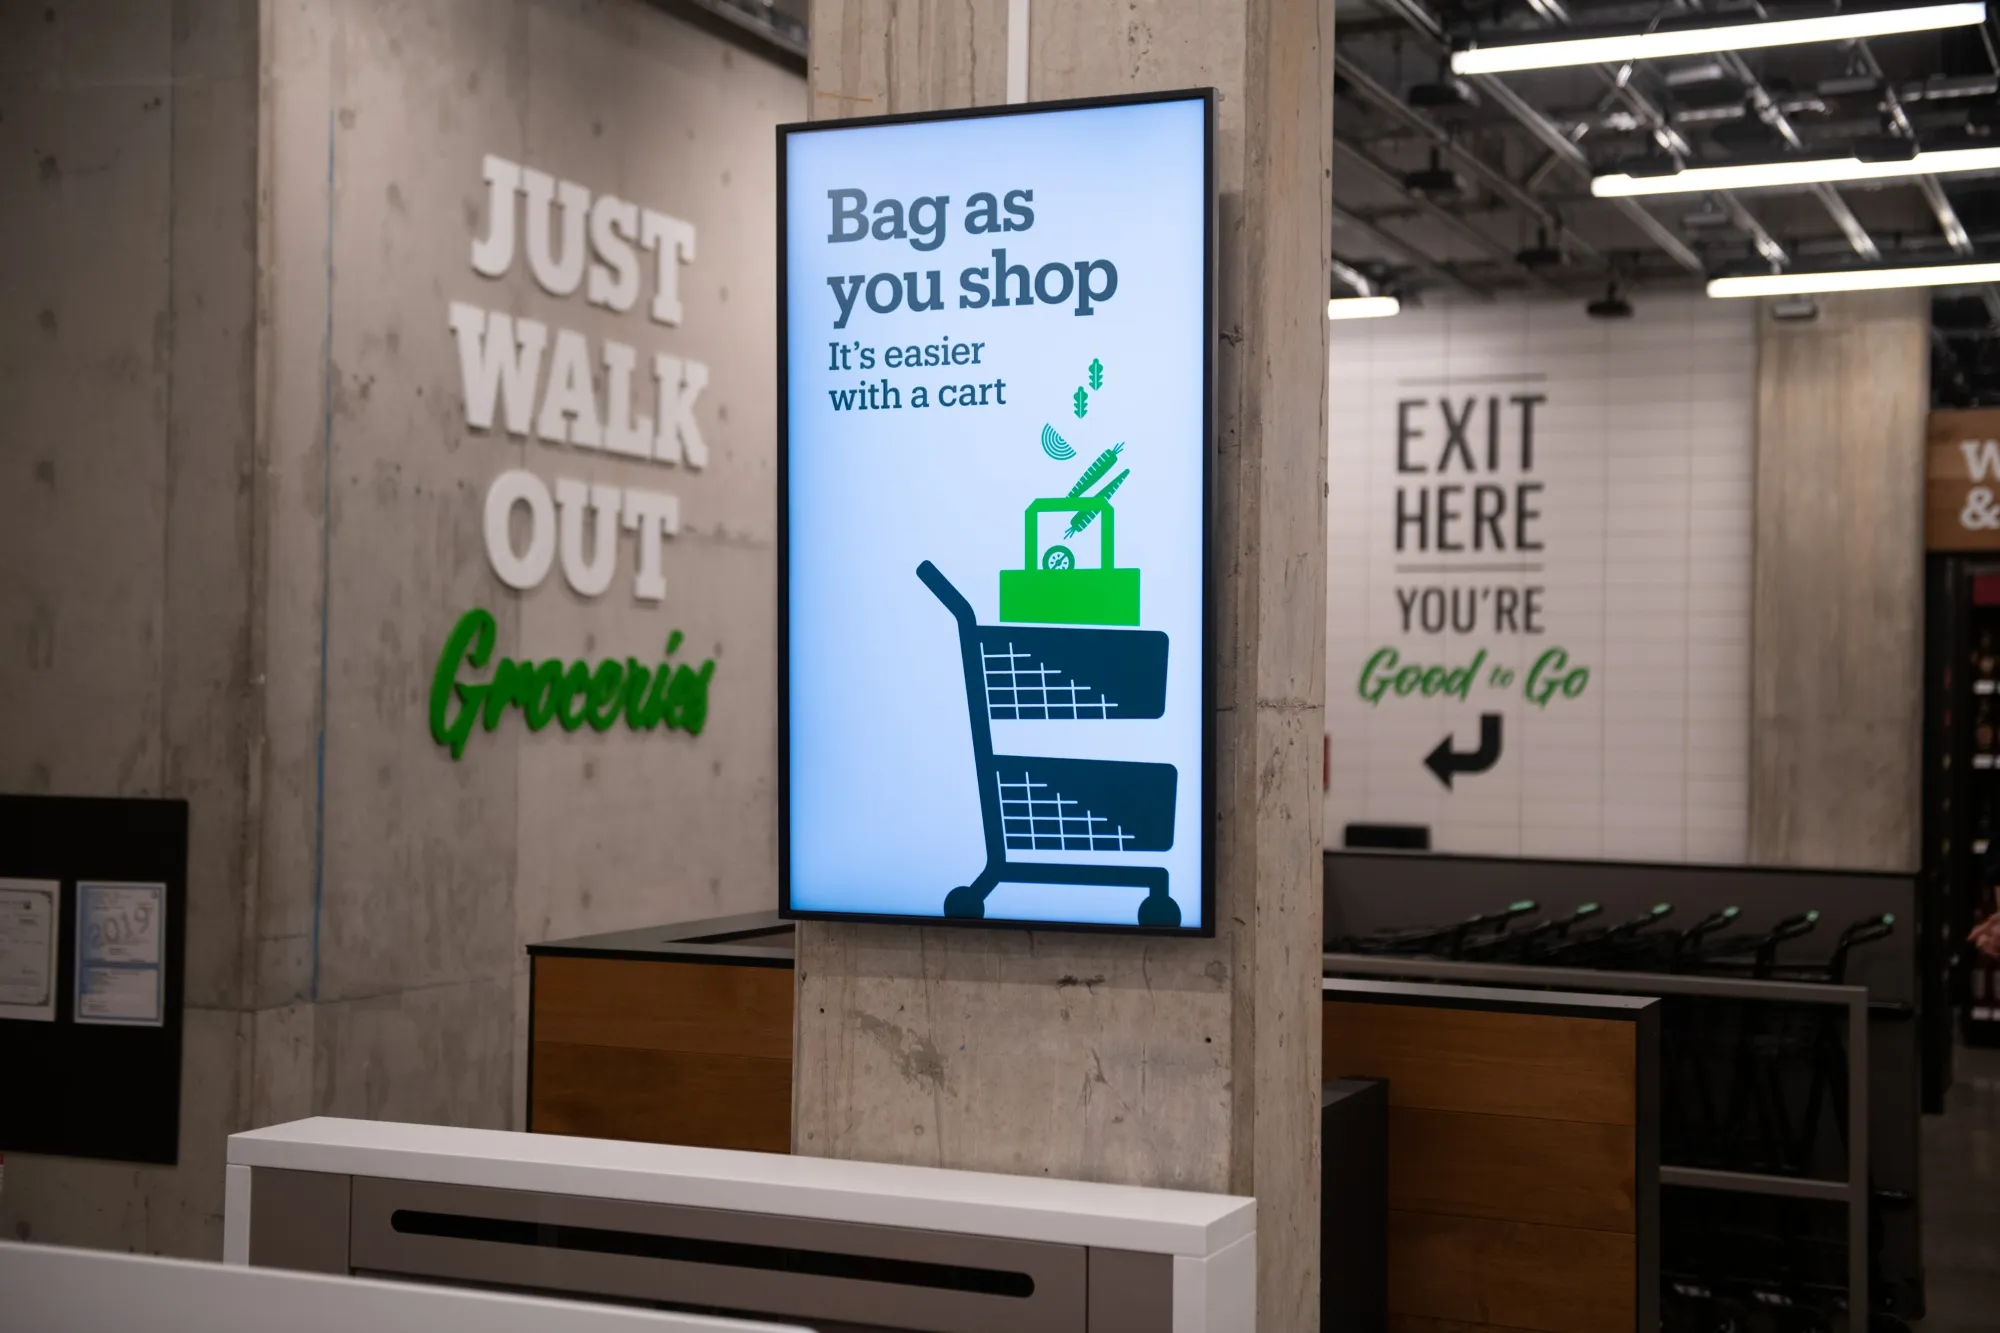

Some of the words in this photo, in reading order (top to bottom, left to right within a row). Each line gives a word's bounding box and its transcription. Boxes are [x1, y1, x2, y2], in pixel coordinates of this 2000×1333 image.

[471, 154, 695, 328] JUST
[827, 188, 950, 252] Bag
[964, 189, 1035, 234] as
[827, 270, 945, 329] you
[959, 248, 1118, 316] shop
[449, 301, 709, 468] WALK
[829, 341, 876, 371] It's
[884, 335, 985, 368] easier
[828, 379, 902, 411] with
[910, 387, 930, 408] a
[938, 378, 1007, 407] cart
[1396, 394, 1547, 474] EXIT
[484, 469, 679, 601] OUT
[1396, 483, 1545, 553] HERE
[1395, 585, 1546, 635] YOU'RE
[429, 607, 715, 761] Groceries
[1357, 646, 1488, 708] Good
[1488, 664, 1516, 690] to
[1525, 646, 1591, 710] Go
